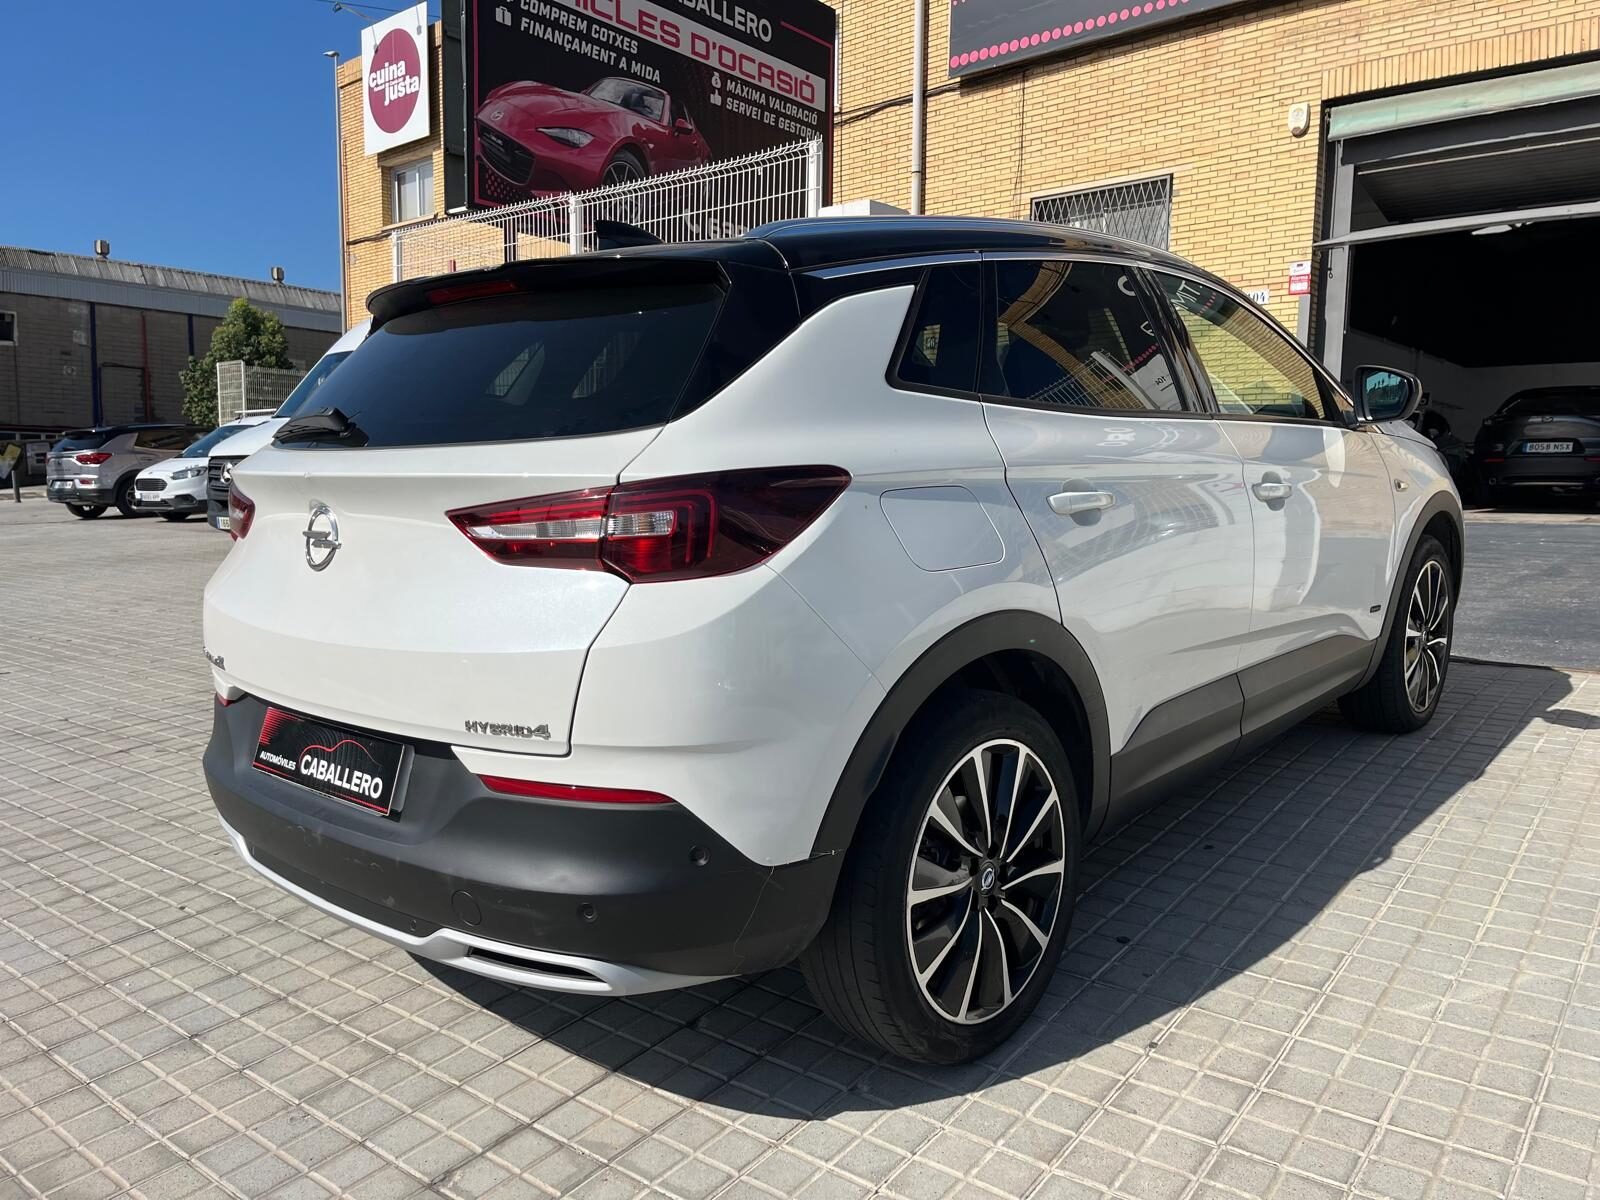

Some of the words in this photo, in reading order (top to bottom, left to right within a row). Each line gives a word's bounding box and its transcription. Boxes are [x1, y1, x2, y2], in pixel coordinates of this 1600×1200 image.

[520, 0, 588, 34] COMPREM
[591, 25, 639, 55] COTXES
[520, 17, 617, 67] FINANÇAMENT
[618, 56, 628, 71] A
[630, 60, 662, 84] MIDA
[369, 60, 406, 88] cuina
[383, 75, 420, 107] justa
[690, 32, 816, 105] D'OCASIÓ
[726, 79, 767, 106] MÀXIMA
[768, 95, 819, 126] VALORACIÓ
[726, 97, 761, 121] SERVEI
[763, 112, 776, 127] DE
[464, 719, 552, 741] HYBRID4
[259, 751, 297, 771] AUTOMÓVILES
[300, 754, 383, 800] CABALLERO
